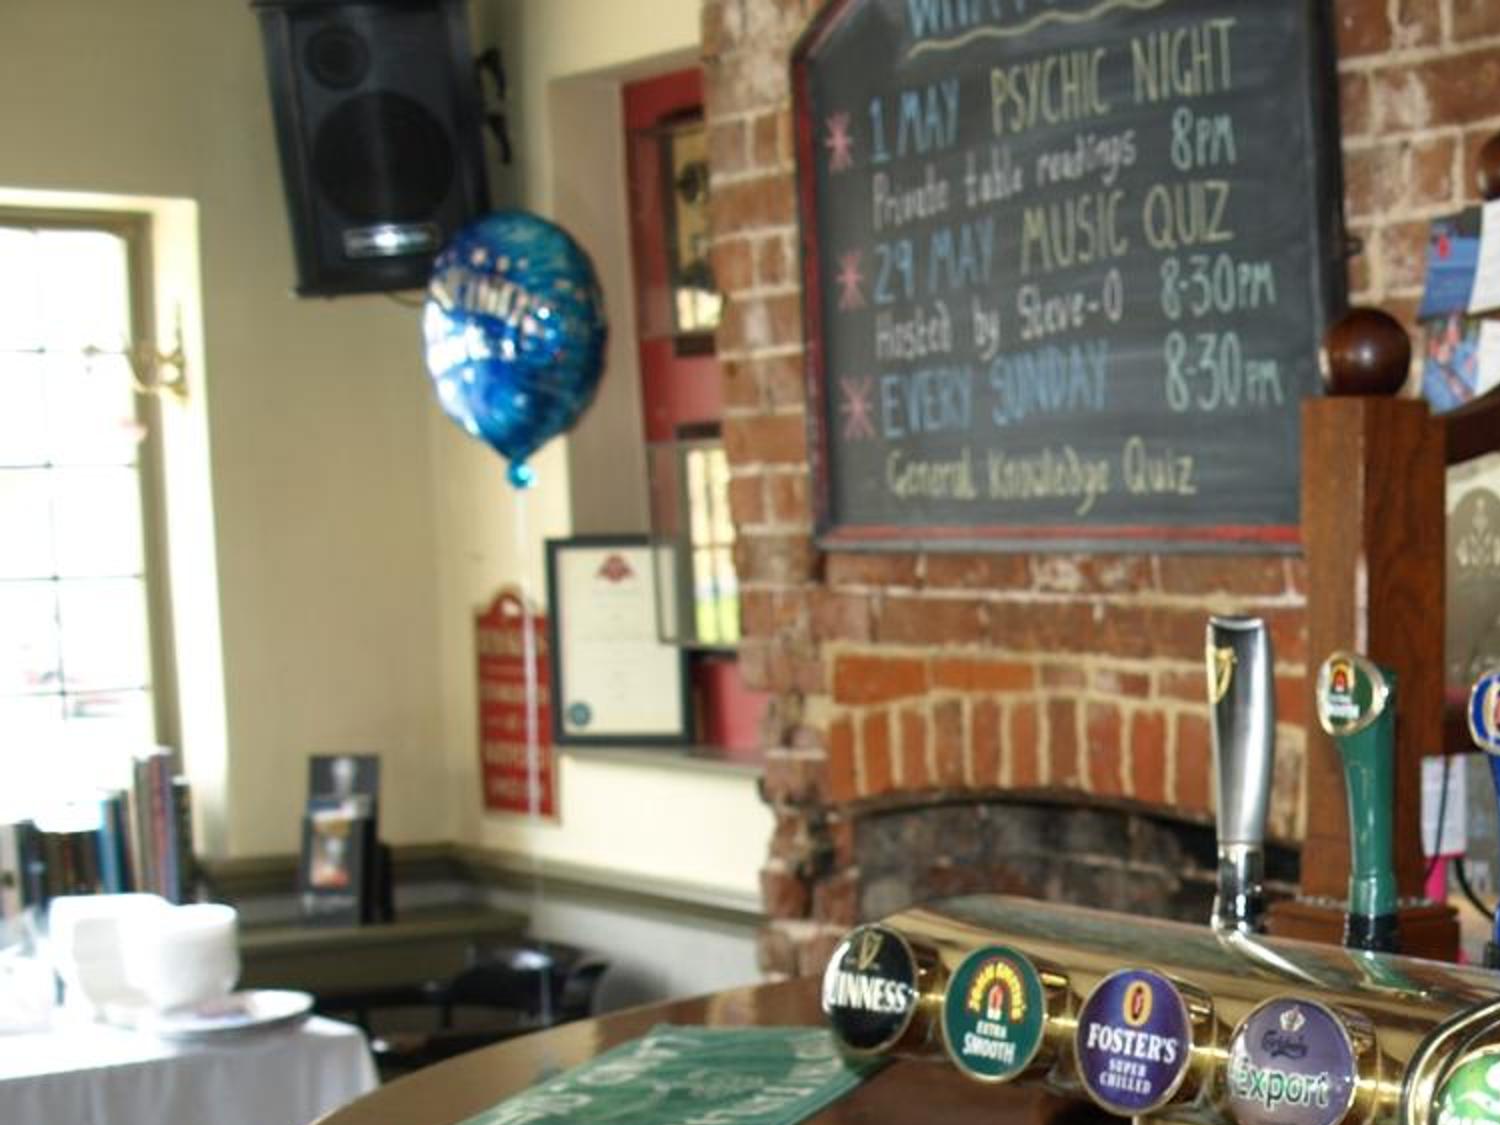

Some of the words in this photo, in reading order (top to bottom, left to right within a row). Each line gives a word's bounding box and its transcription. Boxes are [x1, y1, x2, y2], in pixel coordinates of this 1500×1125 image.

[869, 96, 891, 164] 1
[898, 77, 961, 157] MAY
[990, 47, 1111, 136] PSYCHIC
[1130, 17, 1237, 102] NIGHT
[963, 145, 1025, 207] table
[1036, 129, 1137, 187] readings
[873, 239, 915, 303] 29
[927, 216, 996, 293] MAY
[1020, 190, 1130, 277] MUSIC
[1143, 180, 1235, 251] QUIZ
[875, 299, 952, 360] Hosted
[971, 297, 1000, 360] by
[880, 362, 974, 438] EVERY
[989, 340, 1113, 426] SUNDAY
[886, 447, 976, 500] General
[1123, 434, 1196, 496] Quiz
[829, 970, 908, 1014] UINNESS
[961, 1032, 1017, 1065] SMOOTH
[1087, 1022, 1179, 1065] FOSTER'S
[1108, 1057, 1148, 1078] SUPER
[1099, 1071, 1152, 1095] CHILLED
[1231, 1058, 1331, 1112] Export
